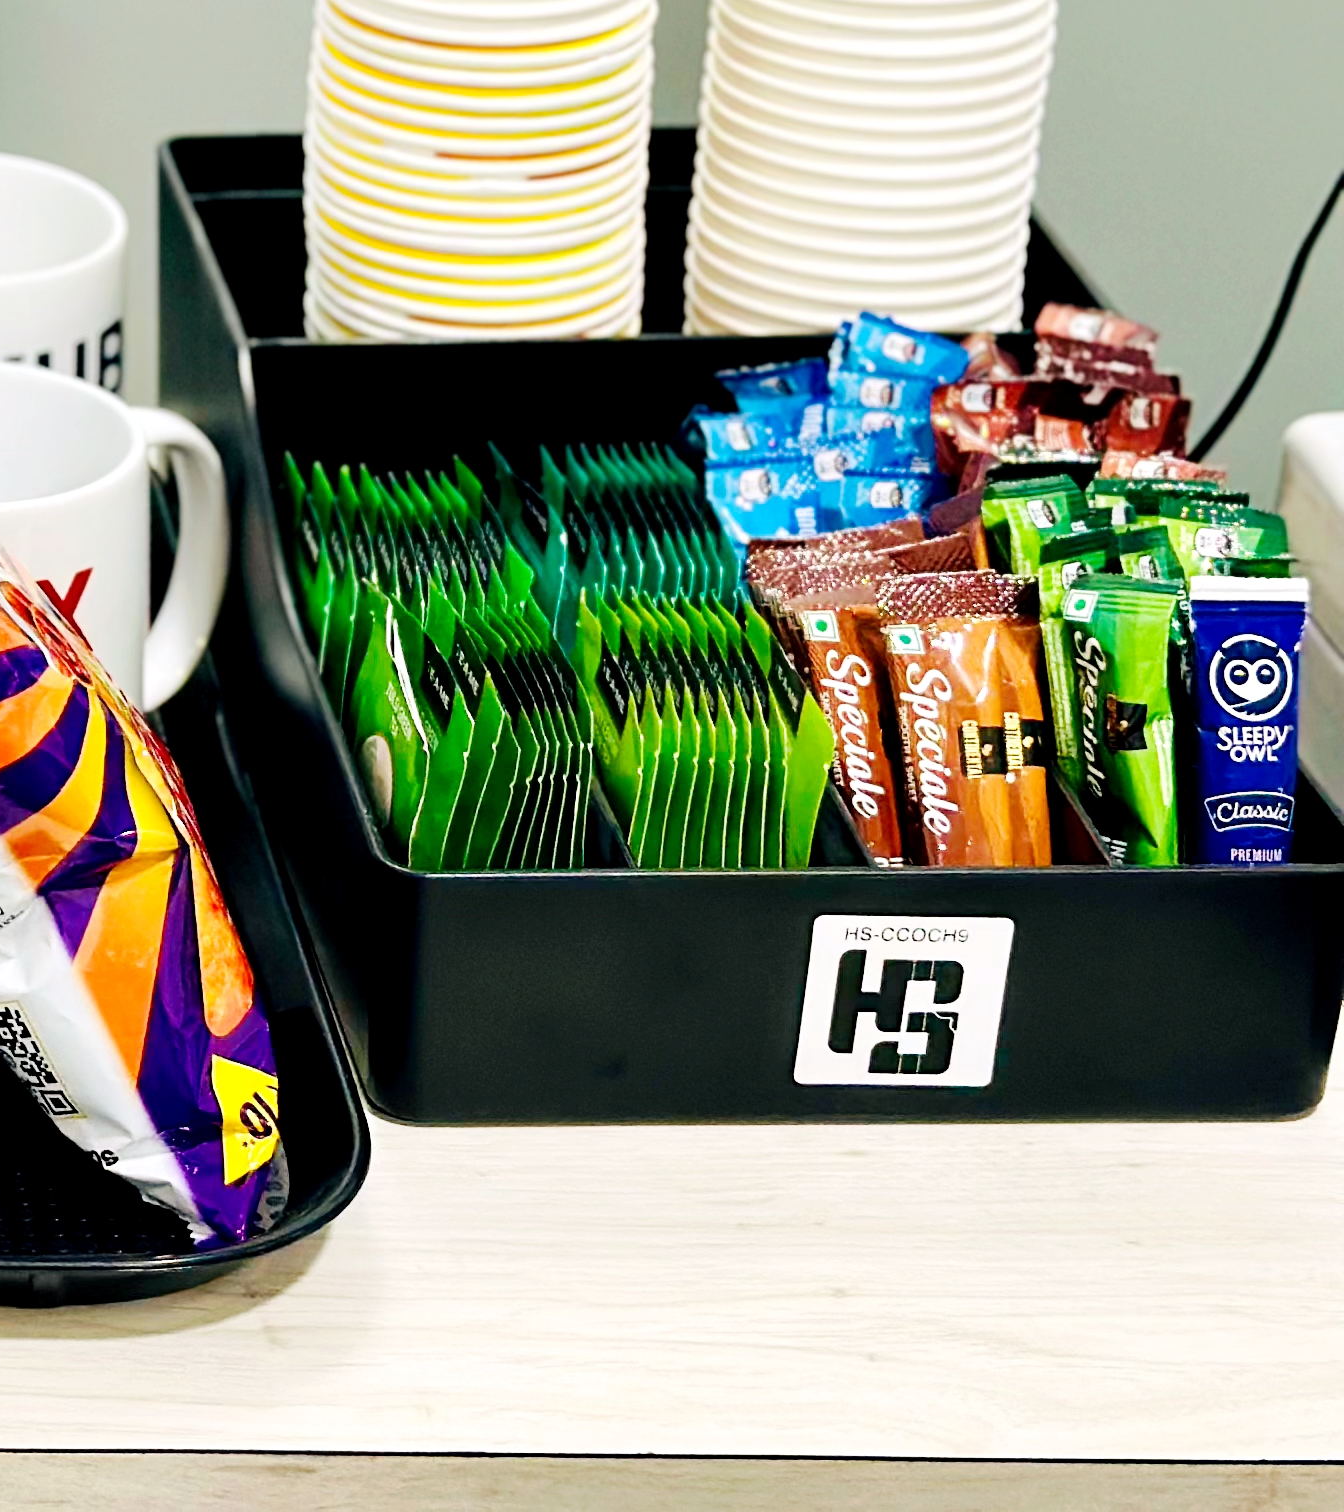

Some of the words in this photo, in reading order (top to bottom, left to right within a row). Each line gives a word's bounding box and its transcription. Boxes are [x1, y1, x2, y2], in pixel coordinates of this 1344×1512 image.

[1217, 725, 1288, 751] SLEEPY
[899, 662, 962, 836] Spéciale
[1230, 745, 1278, 762] OWL
[1216, 802, 1289, 823] Classic
[1230, 848, 1283, 863] PREMIUM
[845, 926, 970, 943] HS-CCOCH9
